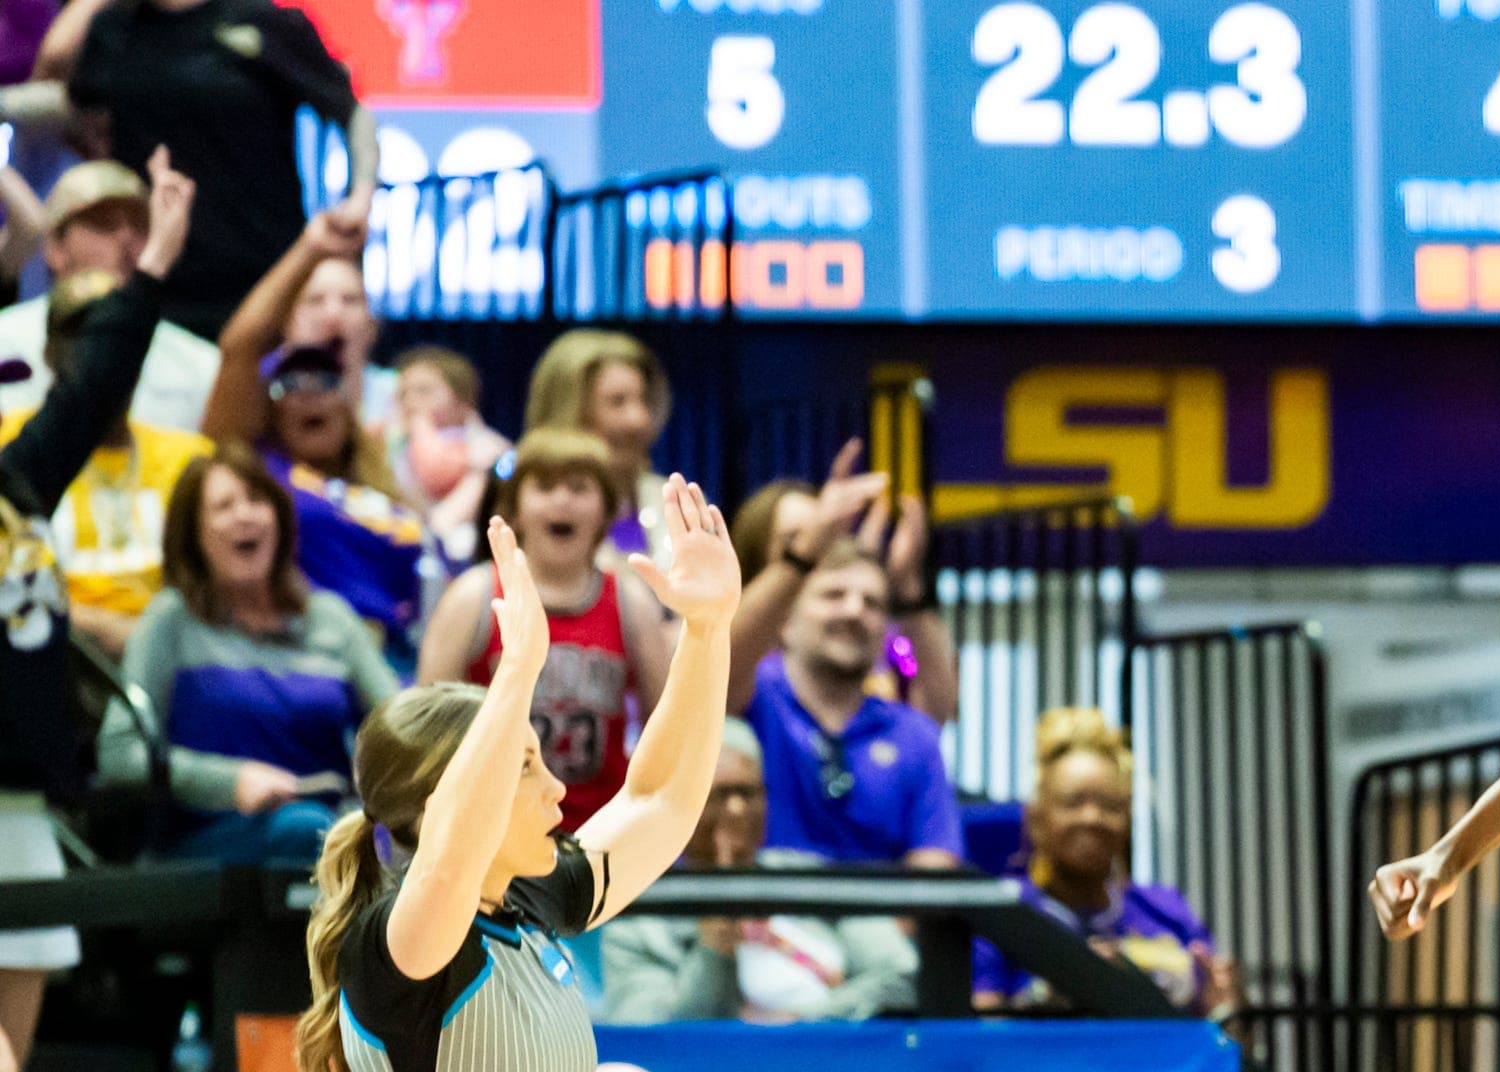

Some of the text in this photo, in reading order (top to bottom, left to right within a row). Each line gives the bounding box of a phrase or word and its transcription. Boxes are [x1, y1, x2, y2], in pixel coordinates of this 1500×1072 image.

[707, 36, 785, 150] 5
[972, 3, 1307, 147] 22.3
[995, 195, 1280, 293] PERIOD 3
[872, 366, 1330, 528] LSU
